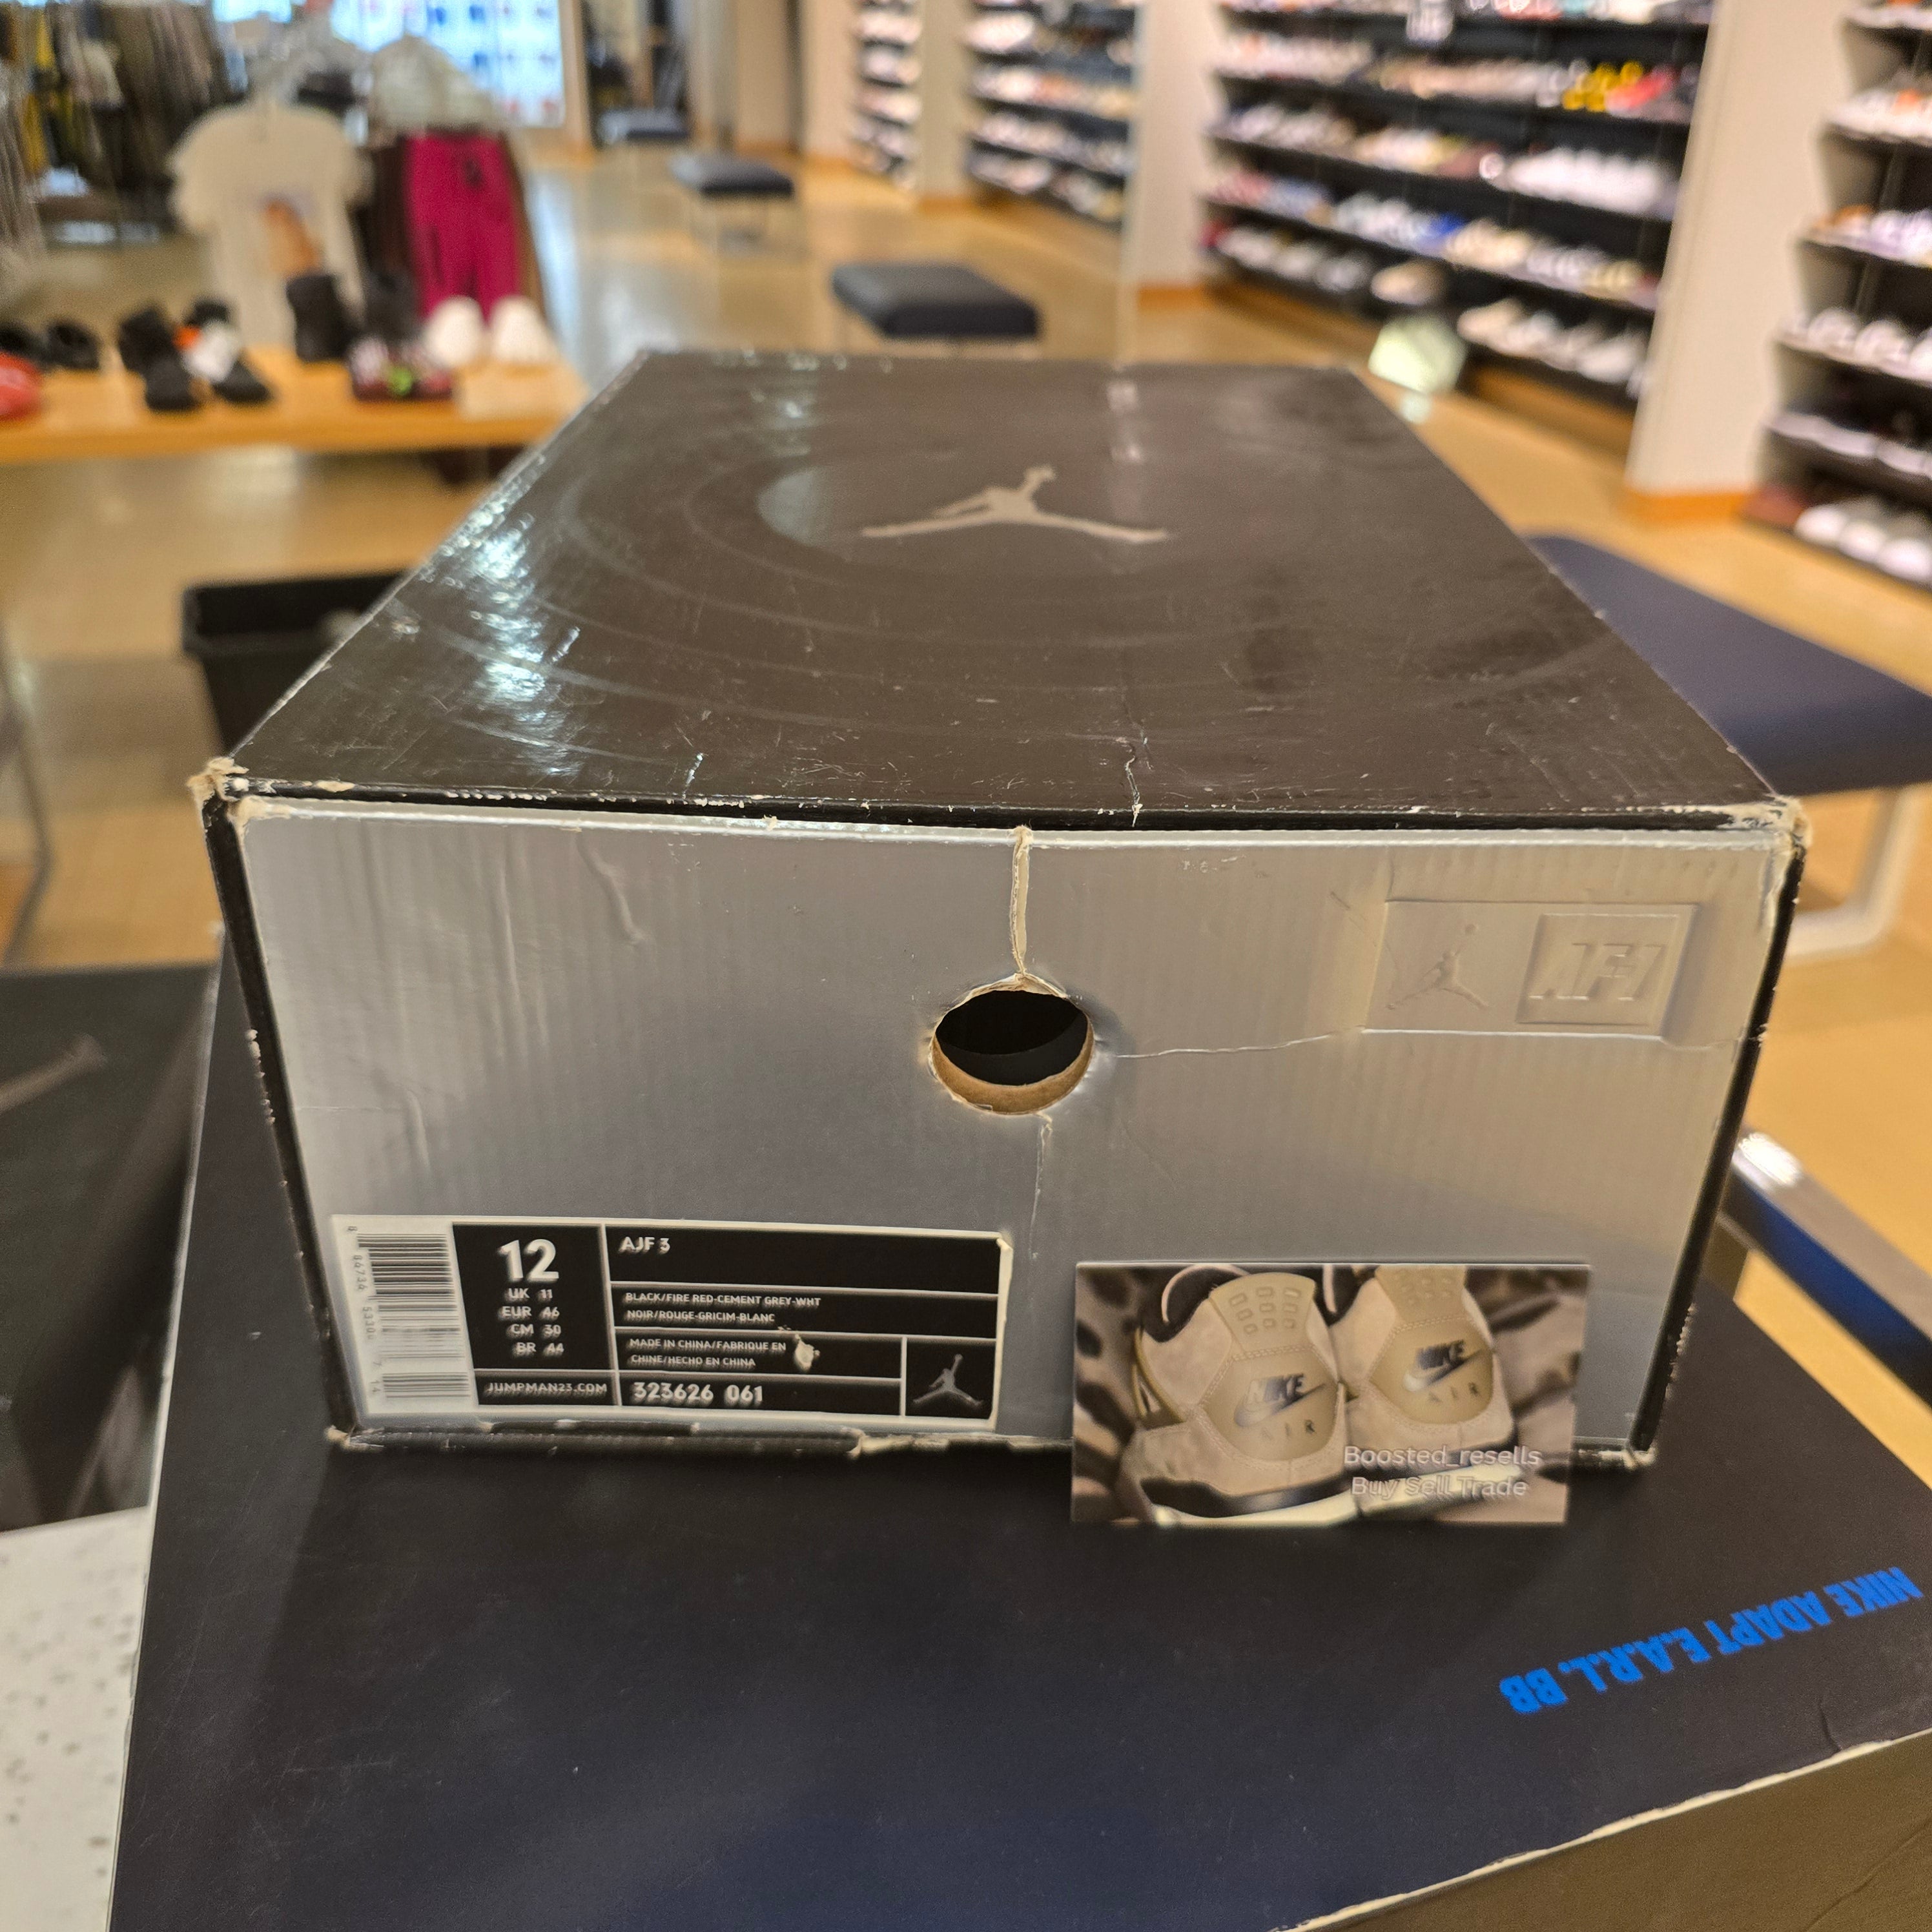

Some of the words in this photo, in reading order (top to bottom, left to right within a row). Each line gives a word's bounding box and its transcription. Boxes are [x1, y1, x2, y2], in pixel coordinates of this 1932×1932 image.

[621, 1237, 655, 1251] AJF
[659, 1238, 670, 1252] 3
[497, 1239, 559, 1281] 12
[506, 1288, 530, 1301] UK
[538, 1289, 553, 1300] 11
[624, 1292, 690, 1303] BLACK/FIRE
[692, 1294, 761, 1304] RED-CEMENT
[764, 1297, 821, 1307] GREY-WHT
[499, 1306, 532, 1320] EUR
[541, 1307, 560, 1320] 46
[508, 1324, 535, 1337] CM
[544, 1325, 561, 1338] 30
[514, 1342, 537, 1355] BR
[545, 1343, 564, 1355] 44
[628, 1339, 661, 1349] MADE
[664, 1340, 675, 1349] IN
[678, 1340, 768, 1351] CHINA/FABRIQUE
[771, 1342, 786, 1353] EN
[629, 1355, 703, 1367] CHINE/HECHO
[705, 1357, 720, 1366] EN
[722, 1358, 756, 1368] CHINA
[486, 1382, 607, 1395] JUMPMAN23.COM
[632, 1382, 714, 1403] 323626
[724, 1384, 763, 1404] 061
[1344, 1445, 1543, 1467] Boosted_resells
[1351, 1476, 1401, 1500] Buy
[1404, 1475, 1452, 1496] Sell
[1456, 1475, 1530, 1497] Trade
[1823, 1567, 1923, 1617] NIKE
[1703, 1590, 1832, 1655] ADAPT
[1499, 1668, 1568, 1714] BB
